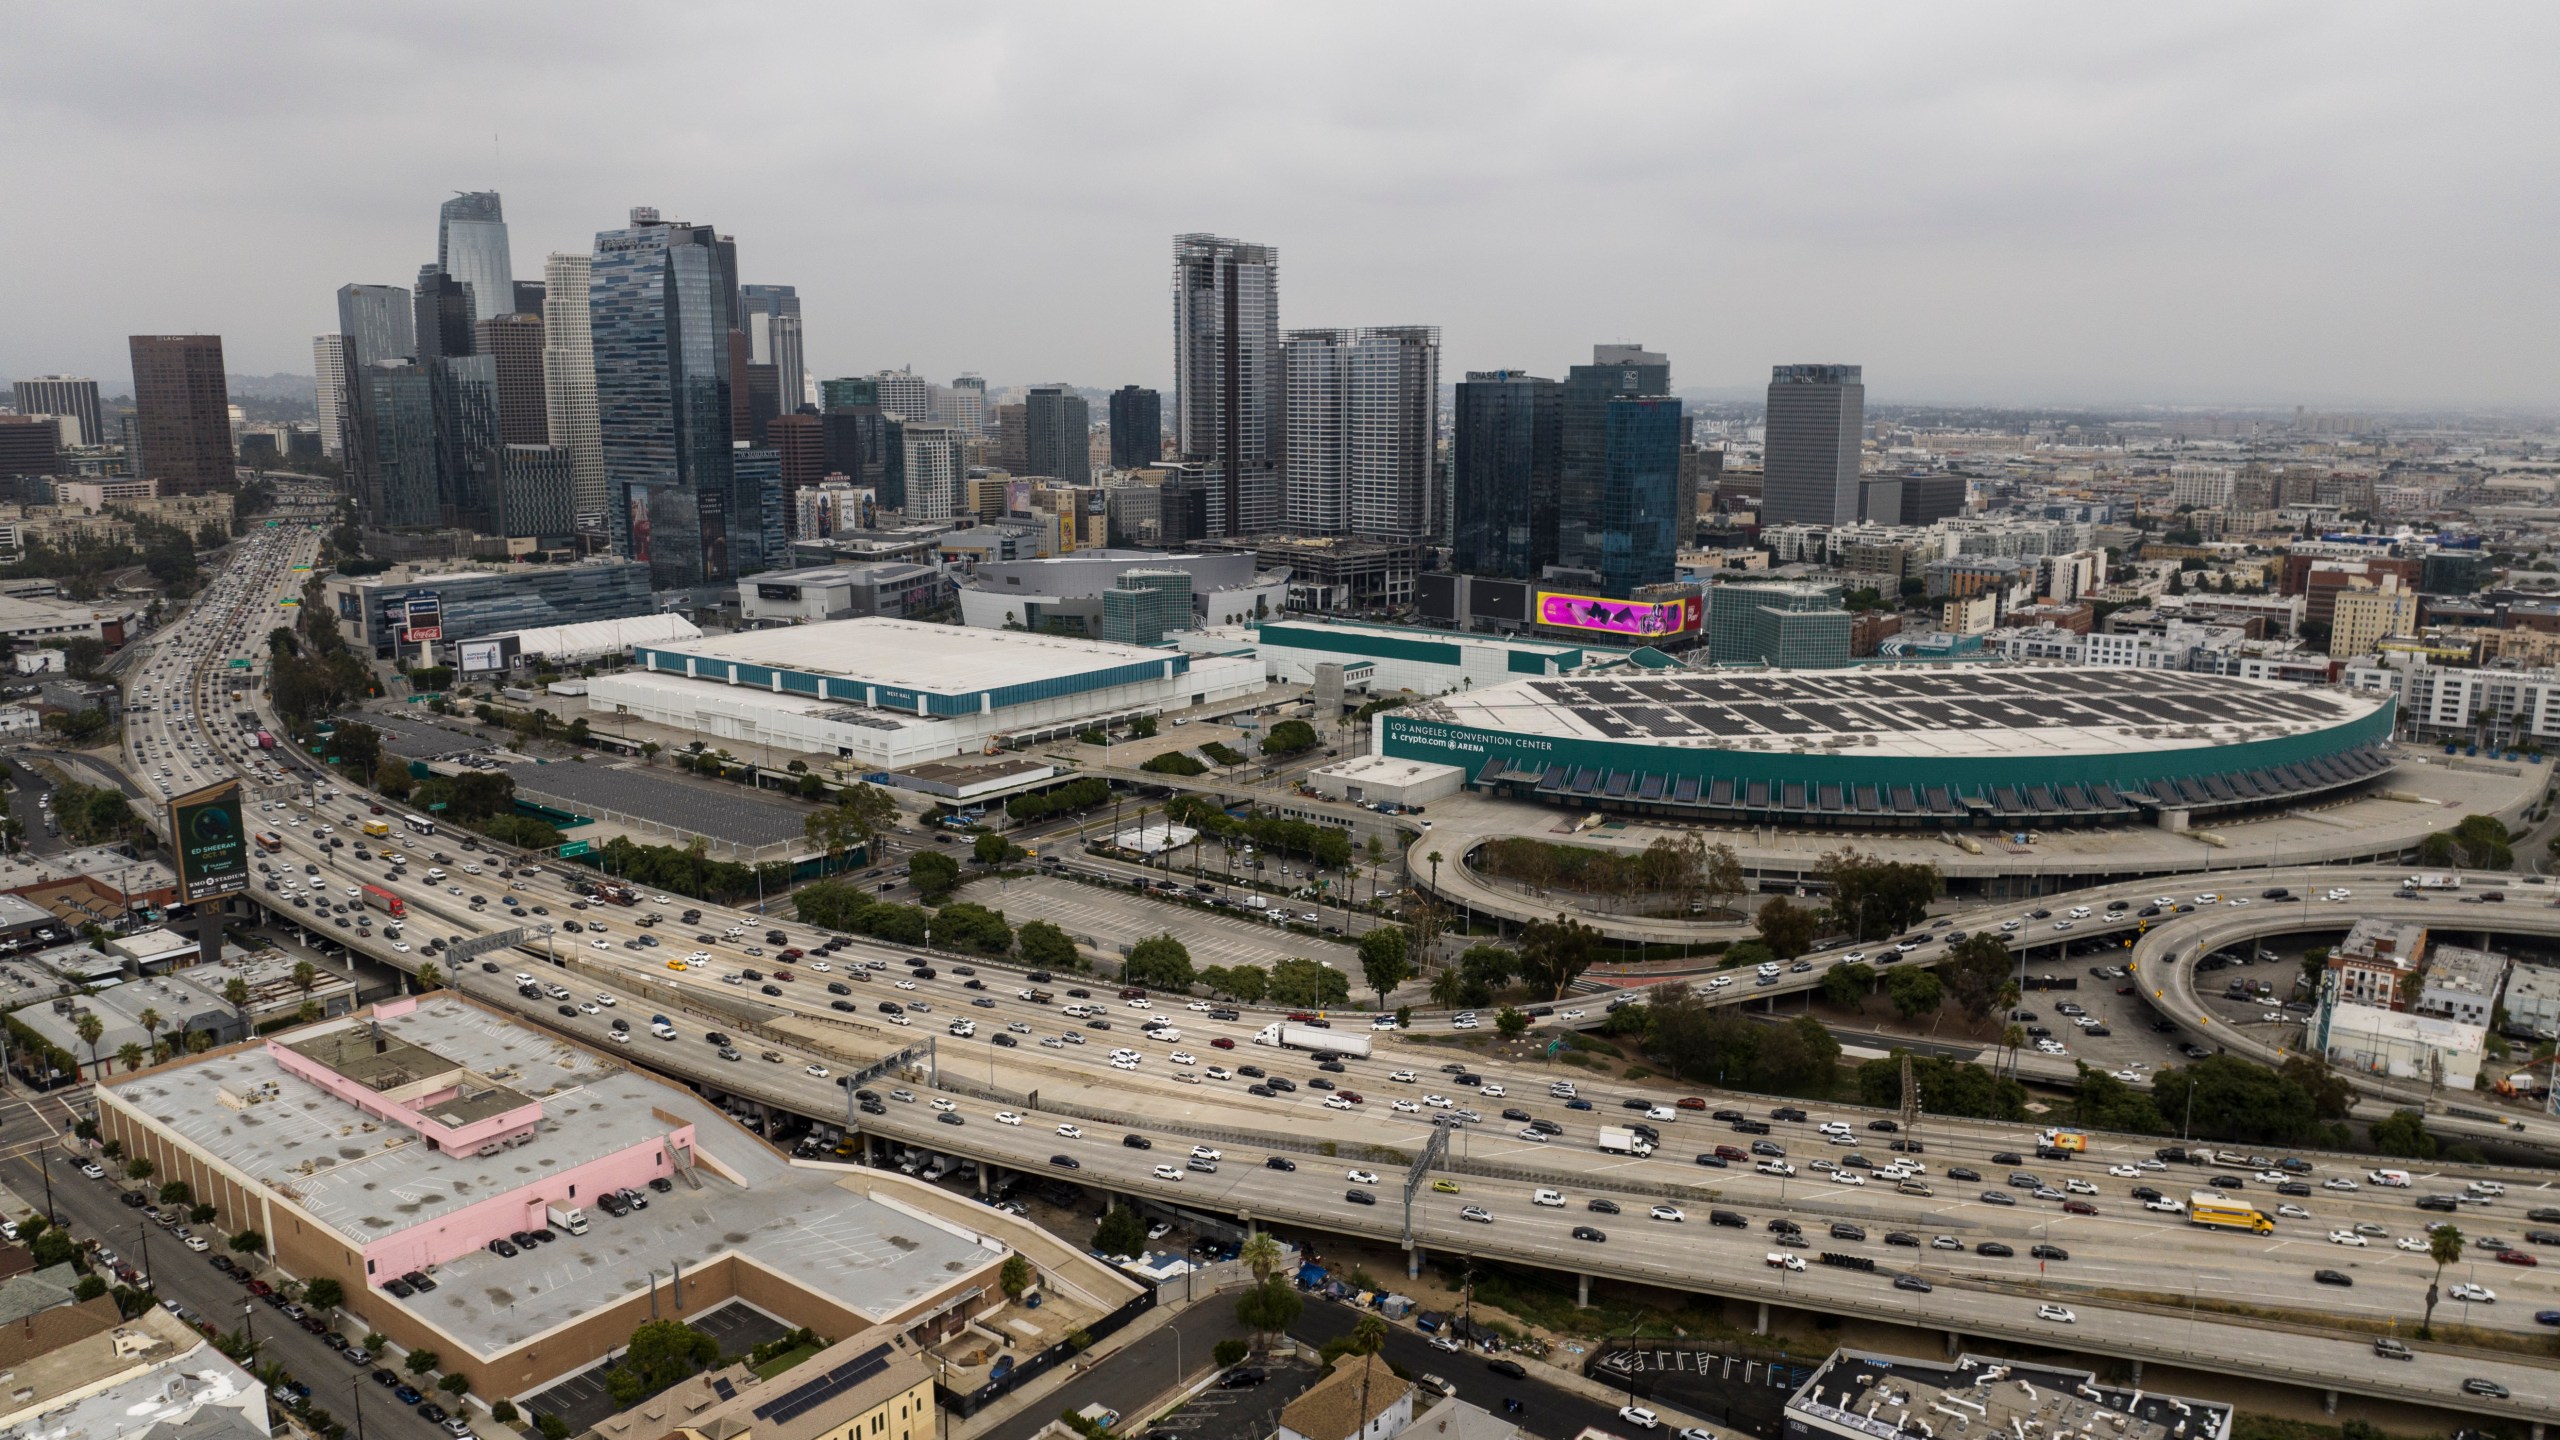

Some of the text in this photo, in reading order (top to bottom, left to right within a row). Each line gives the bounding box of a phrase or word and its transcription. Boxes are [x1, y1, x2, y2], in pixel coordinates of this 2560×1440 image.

[1471, 372, 1497, 380] CHASE
[1624, 371, 1638, 380] AC
[1801, 375, 1816, 384] USC
[1391, 722, 1553, 751] LOS ANGELES CONVENTION CENTER
[1400, 733, 1447, 747] crypto.com
[1457, 743, 1485, 753] ARENA
[202, 842, 237, 853] SHEERAN
[214, 872, 246, 883] STADIUM
